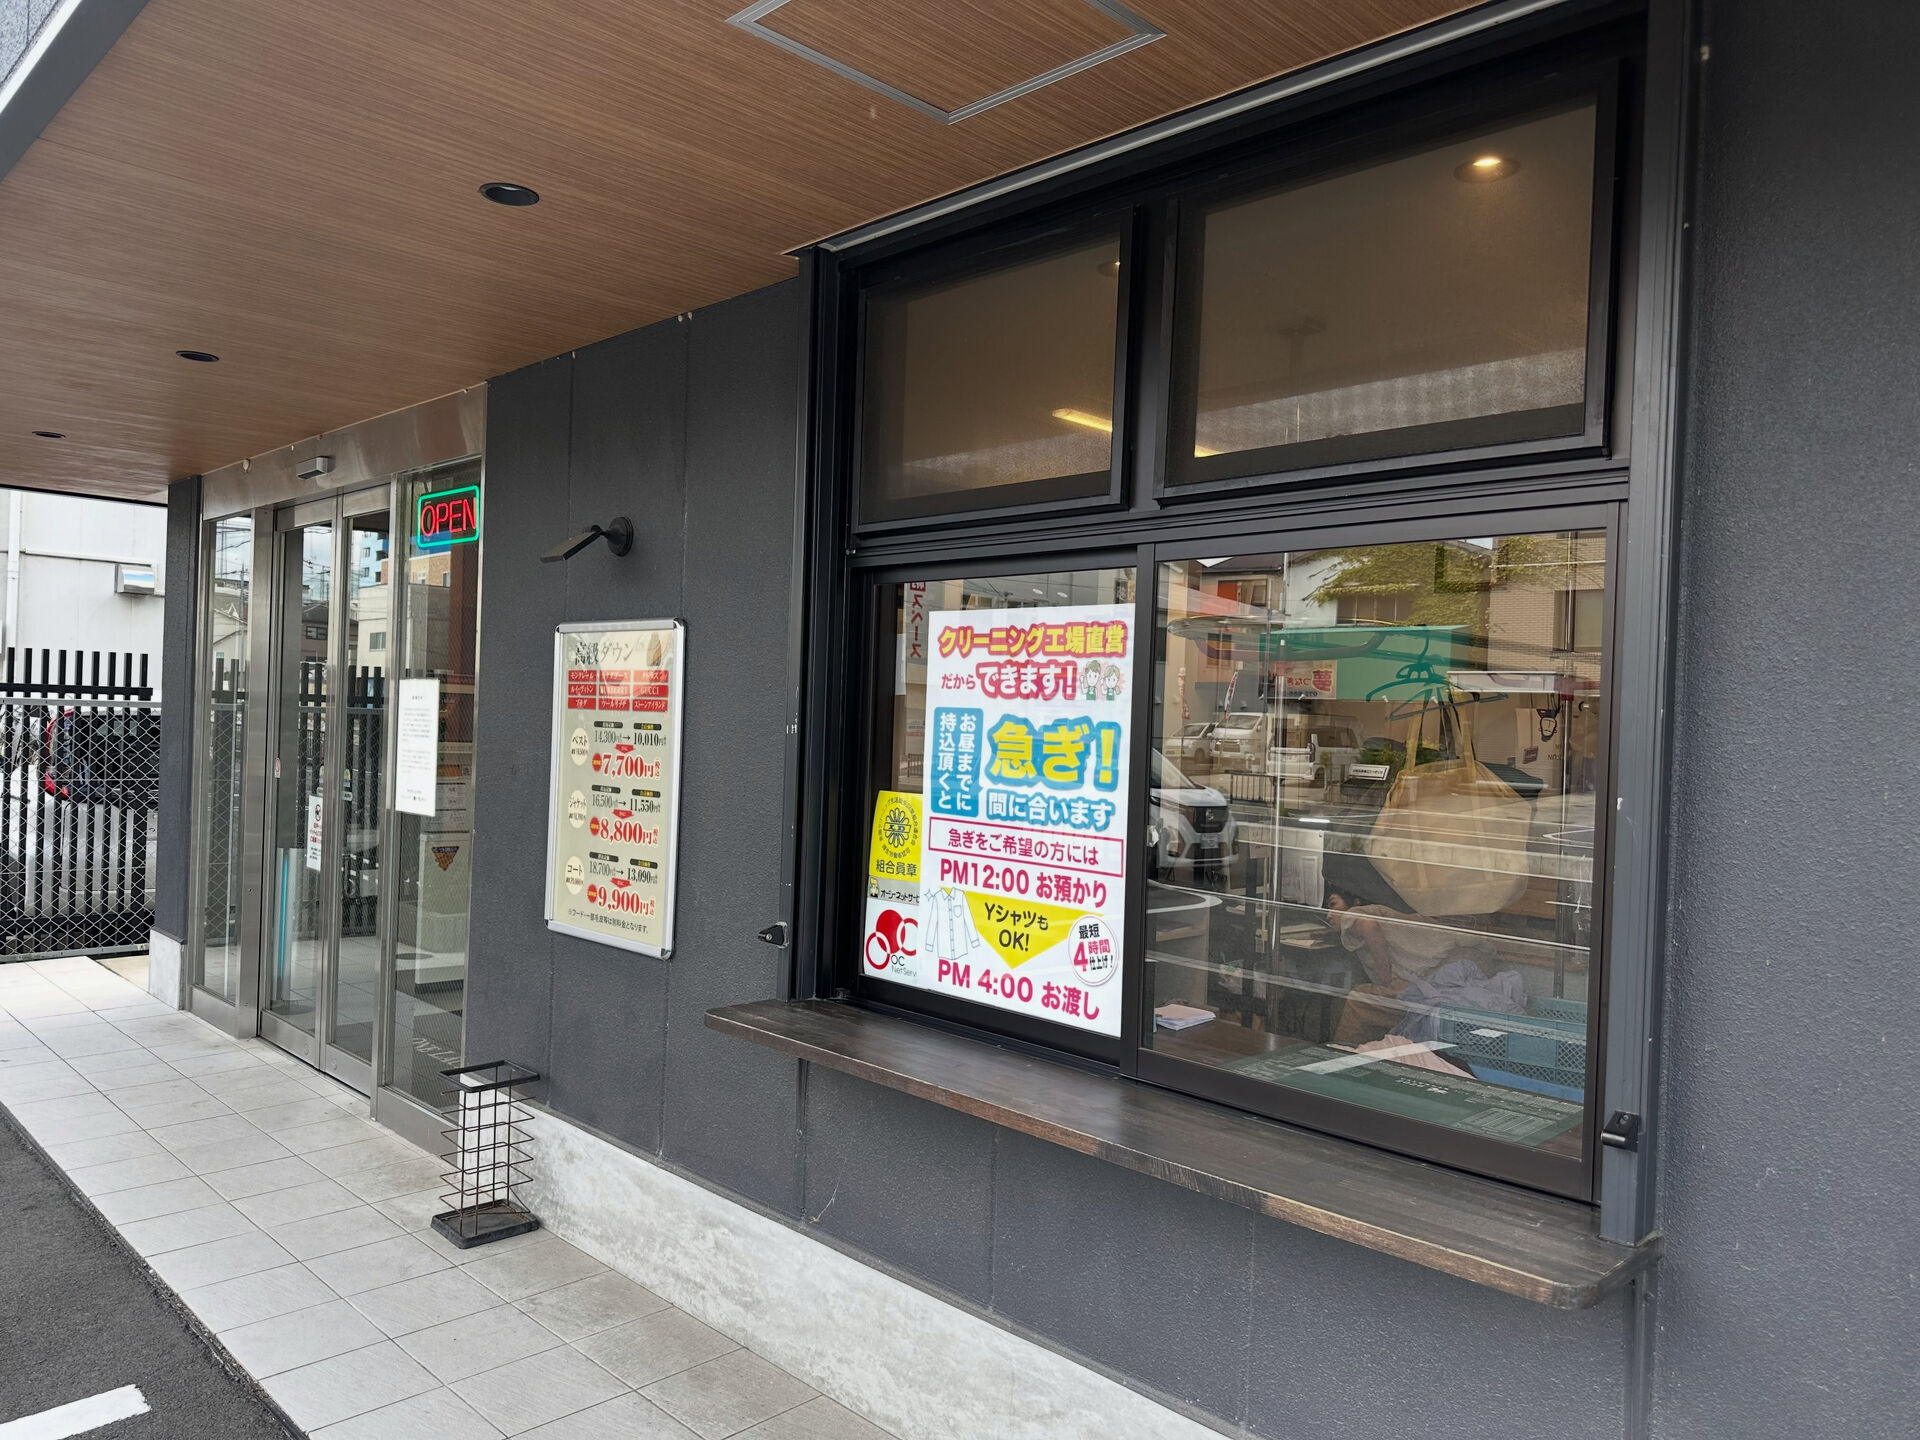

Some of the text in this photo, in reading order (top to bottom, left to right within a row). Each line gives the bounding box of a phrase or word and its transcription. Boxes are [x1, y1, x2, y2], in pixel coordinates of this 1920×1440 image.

[421, 497, 477, 537] OPEN
[939, 621, 1127, 657] クリーニング工場直営
[941, 662, 1076, 698] だから できます!
[938, 712, 957, 810] 持込頂くと
[956, 712, 977, 811] お昼までに
[991, 719, 1115, 785] 急ぎ!
[988, 791, 1113, 829] 間に合います
[948, 828, 1099, 866] 急ぎをご希望の方には
[876, 859, 917, 877] 組合員章
[940, 858, 1107, 908] PM12:00 お預かり
[984, 902, 1049, 931] Yシャツも
[1079, 923, 1100, 939] 最短
[891, 954, 905, 966] OC
[999, 929, 1030, 953] OK!
[938, 958, 1100, 1020] PM 4:00 お渡し
